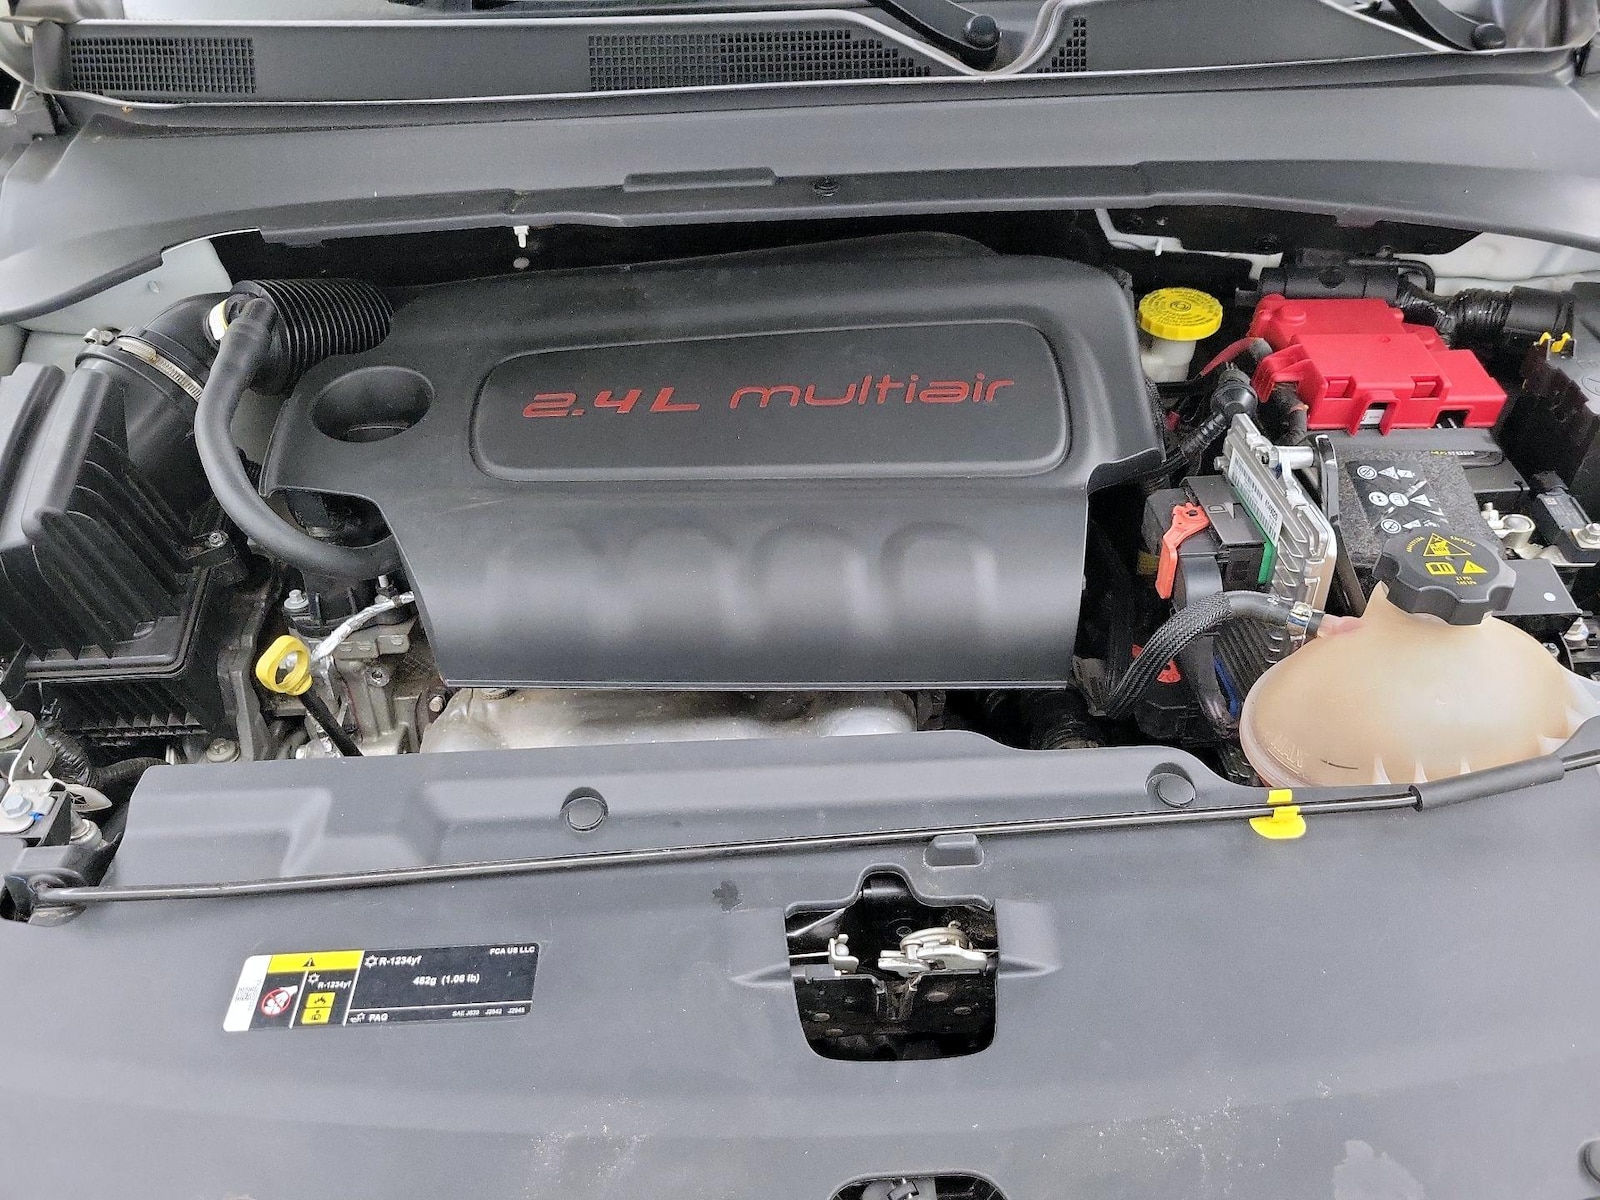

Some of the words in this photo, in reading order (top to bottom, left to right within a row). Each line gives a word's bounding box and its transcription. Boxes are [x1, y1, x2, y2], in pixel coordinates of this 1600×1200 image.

[730, 373, 1013, 409] multiair
[489, 947, 505, 956] FCA
[507, 946, 518, 955] US
[519, 945, 536, 955] LLC
[378, 955, 423, 967] R-1234yf
[369, 1012, 389, 1022] PAG
